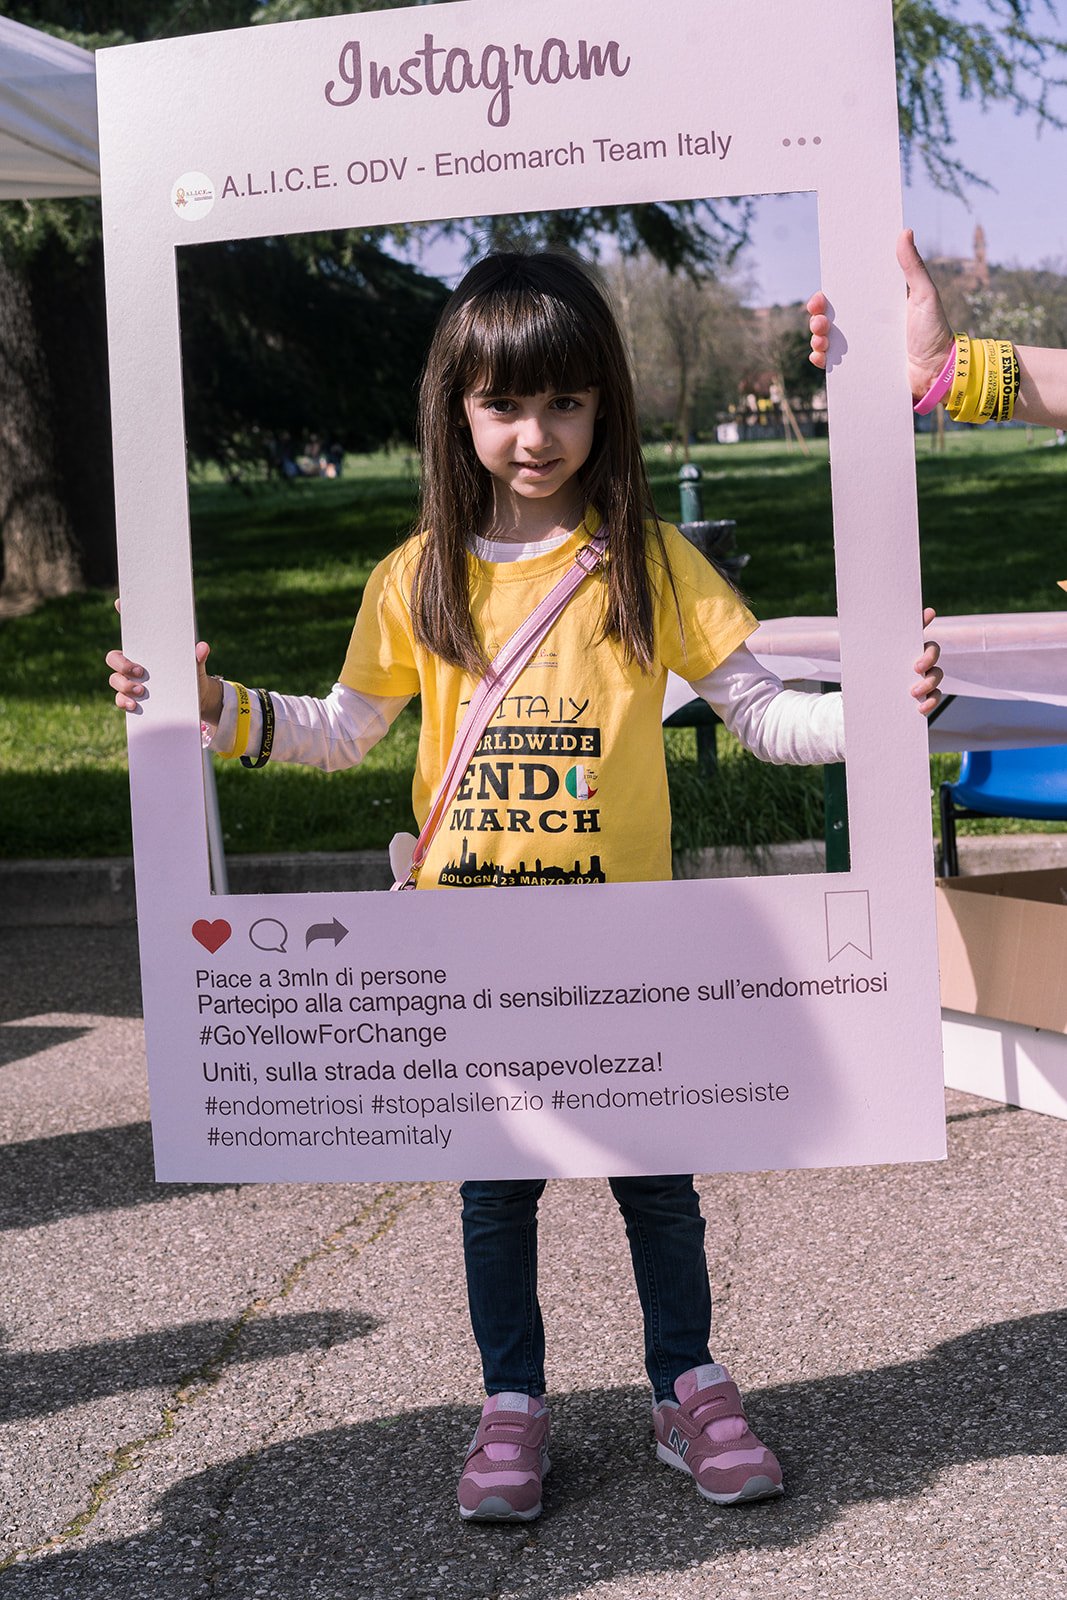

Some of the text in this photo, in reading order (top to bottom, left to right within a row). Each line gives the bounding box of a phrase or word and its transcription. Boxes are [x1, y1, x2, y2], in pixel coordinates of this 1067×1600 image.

[324, 33, 631, 128] Instagram
[222, 165, 338, 200] A.L.I.C.E.
[347, 157, 408, 186] ODV
[435, 141, 586, 177] Endomarch
[593, 138, 667, 163] Team
[678, 130, 733, 160] Italy
[497, 696, 590, 724] ITALY
[450, 809, 601, 832] MARCH
[441, 873, 599, 886] BOLOGNA 23 MARZO 2024
[196, 967, 447, 992] Piace a 3mln di persone
[197, 992, 299, 1019] Partecipo
[305, 992, 344, 1013] alla
[349, 992, 468, 1017] campagna
[473, 989, 493, 1009] di
[500, 983, 691, 1009] sensibilizzazione
[199, 1022, 448, 1048] #GoYellowForChange
[202, 1052, 663, 1085] Uniti, sulla strada della consapevolezza!
[205, 1081, 790, 1118] #endometriosi #stopalsilenzio #endometriosiesiste
[207, 1124, 452, 1150] #endomarchteamitaly
